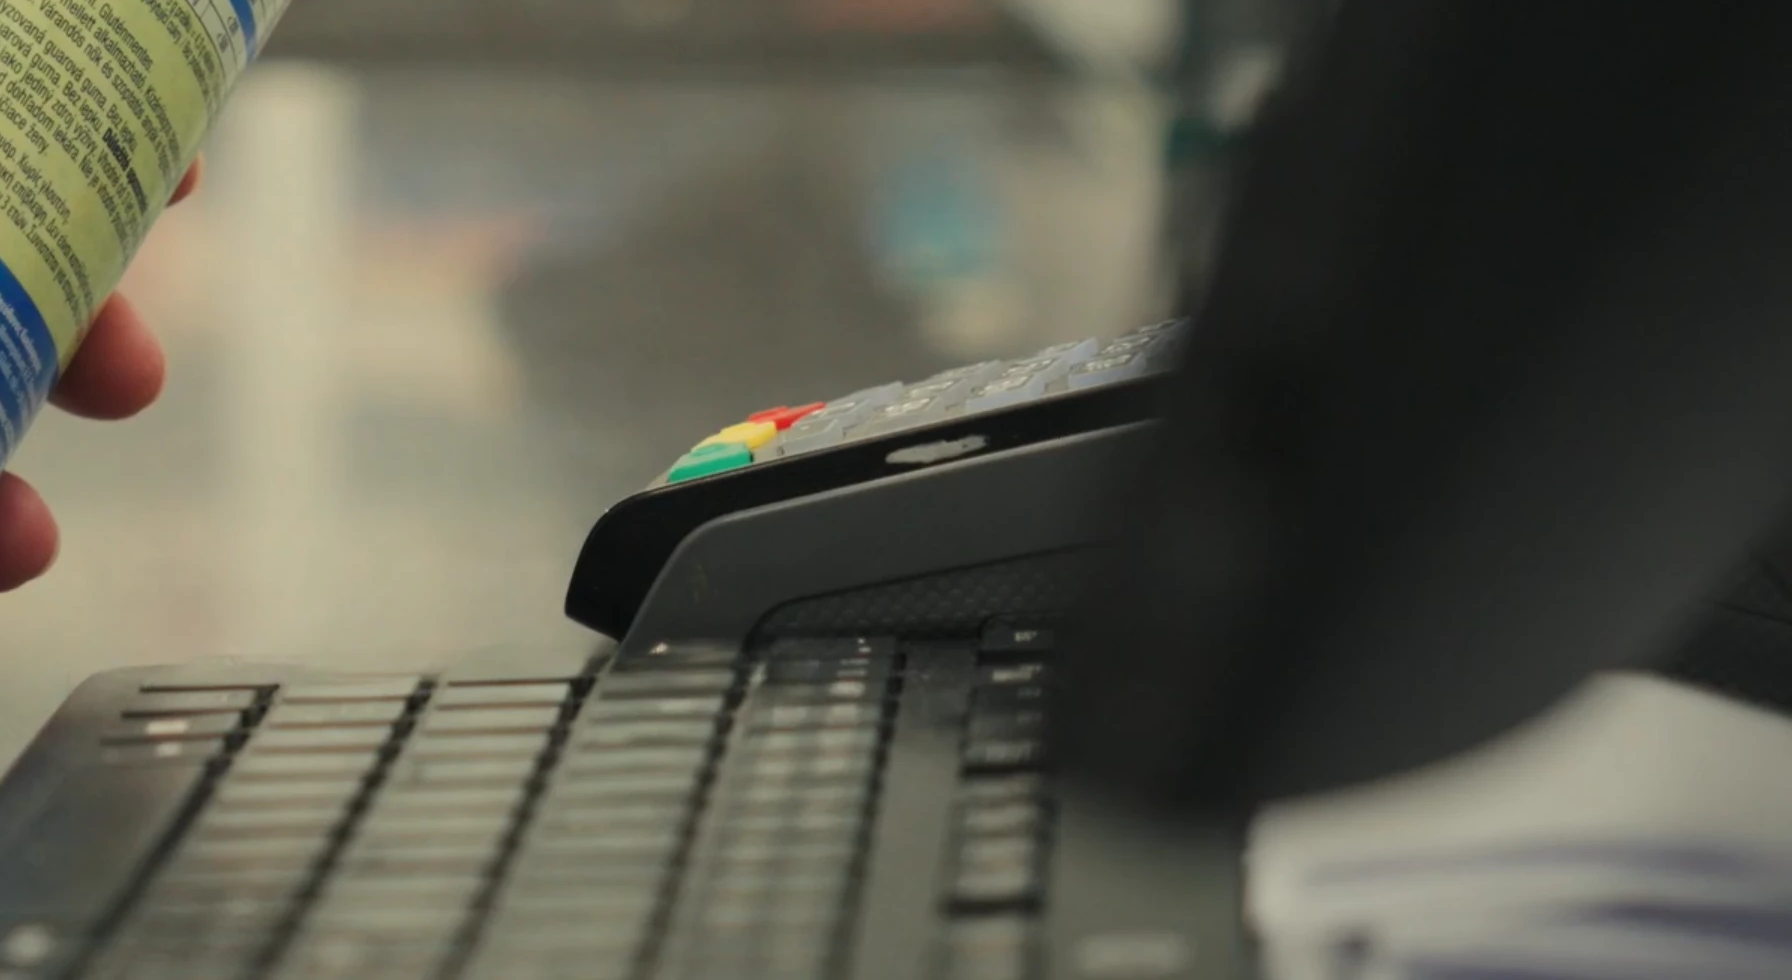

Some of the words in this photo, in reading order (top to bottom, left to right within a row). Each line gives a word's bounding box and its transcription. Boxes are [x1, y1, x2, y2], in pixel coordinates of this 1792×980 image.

[43, 39, 85, 83] guarová
[99, 59, 114, 79] és
[50, 98, 75, 130] zdroj
